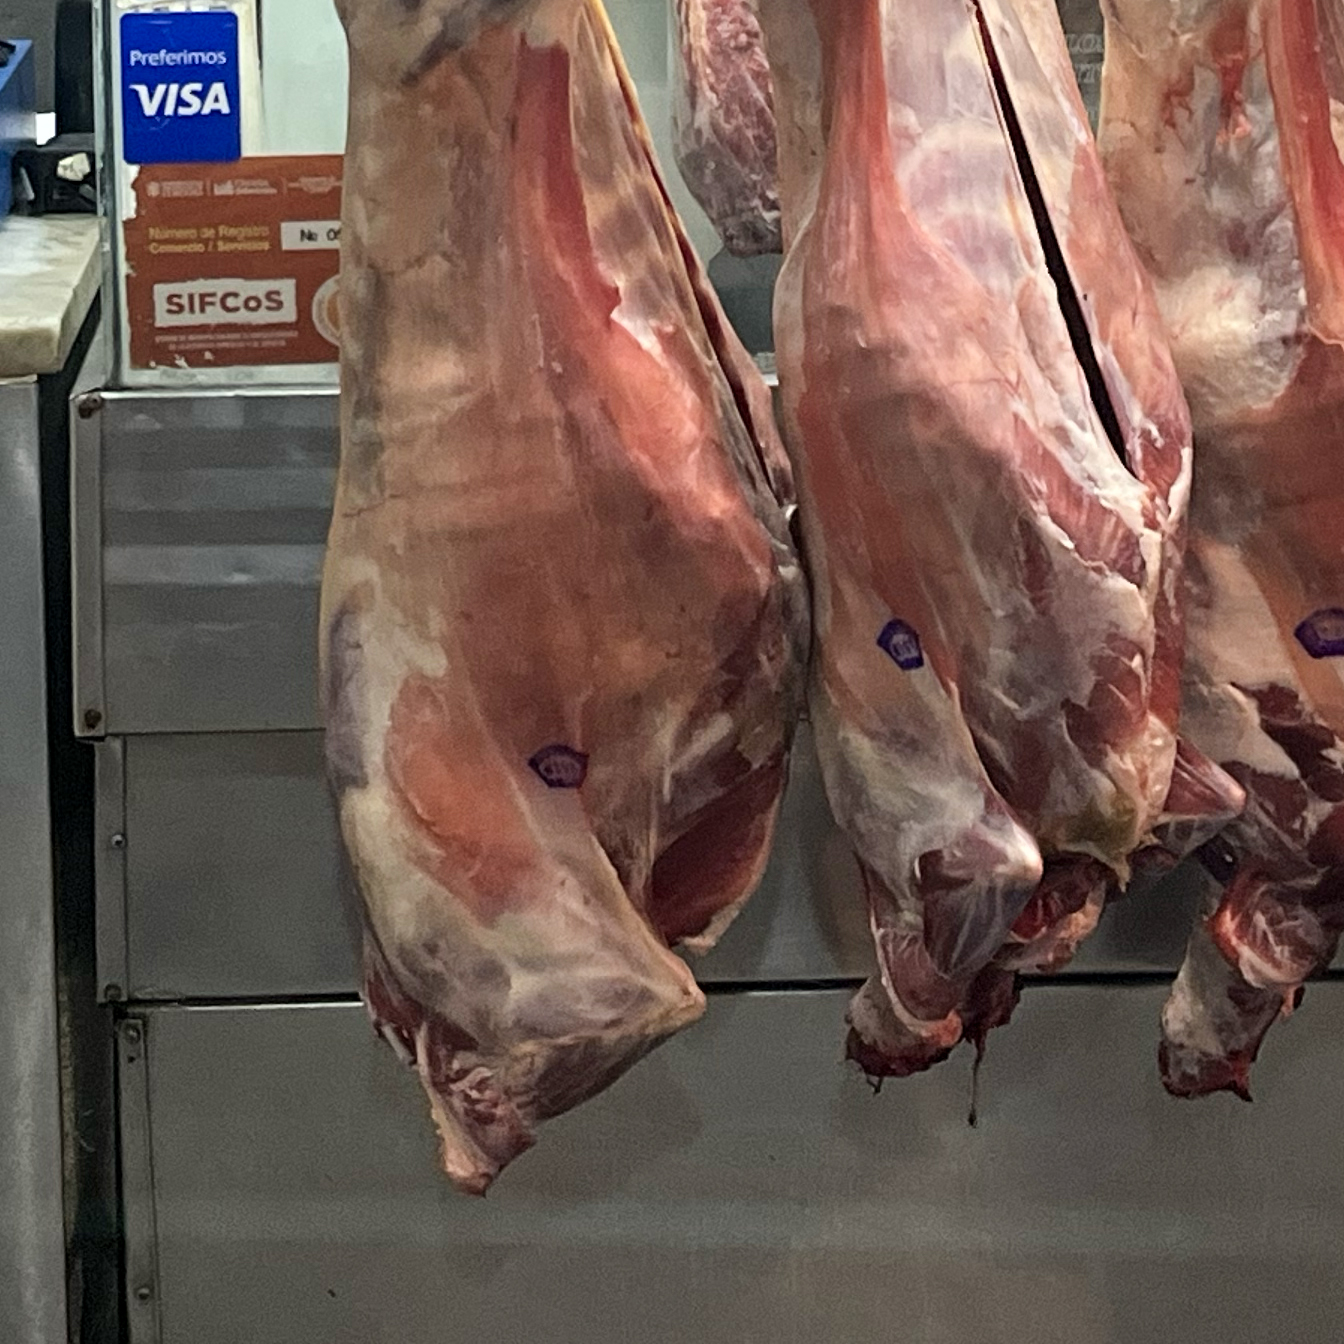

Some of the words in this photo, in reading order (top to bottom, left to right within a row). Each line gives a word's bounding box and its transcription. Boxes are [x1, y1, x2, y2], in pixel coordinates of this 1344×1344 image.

[129, 49, 227, 66] Preferimos
[128, 82, 231, 117] VISA
[165, 290, 285, 315] SIFCoS
